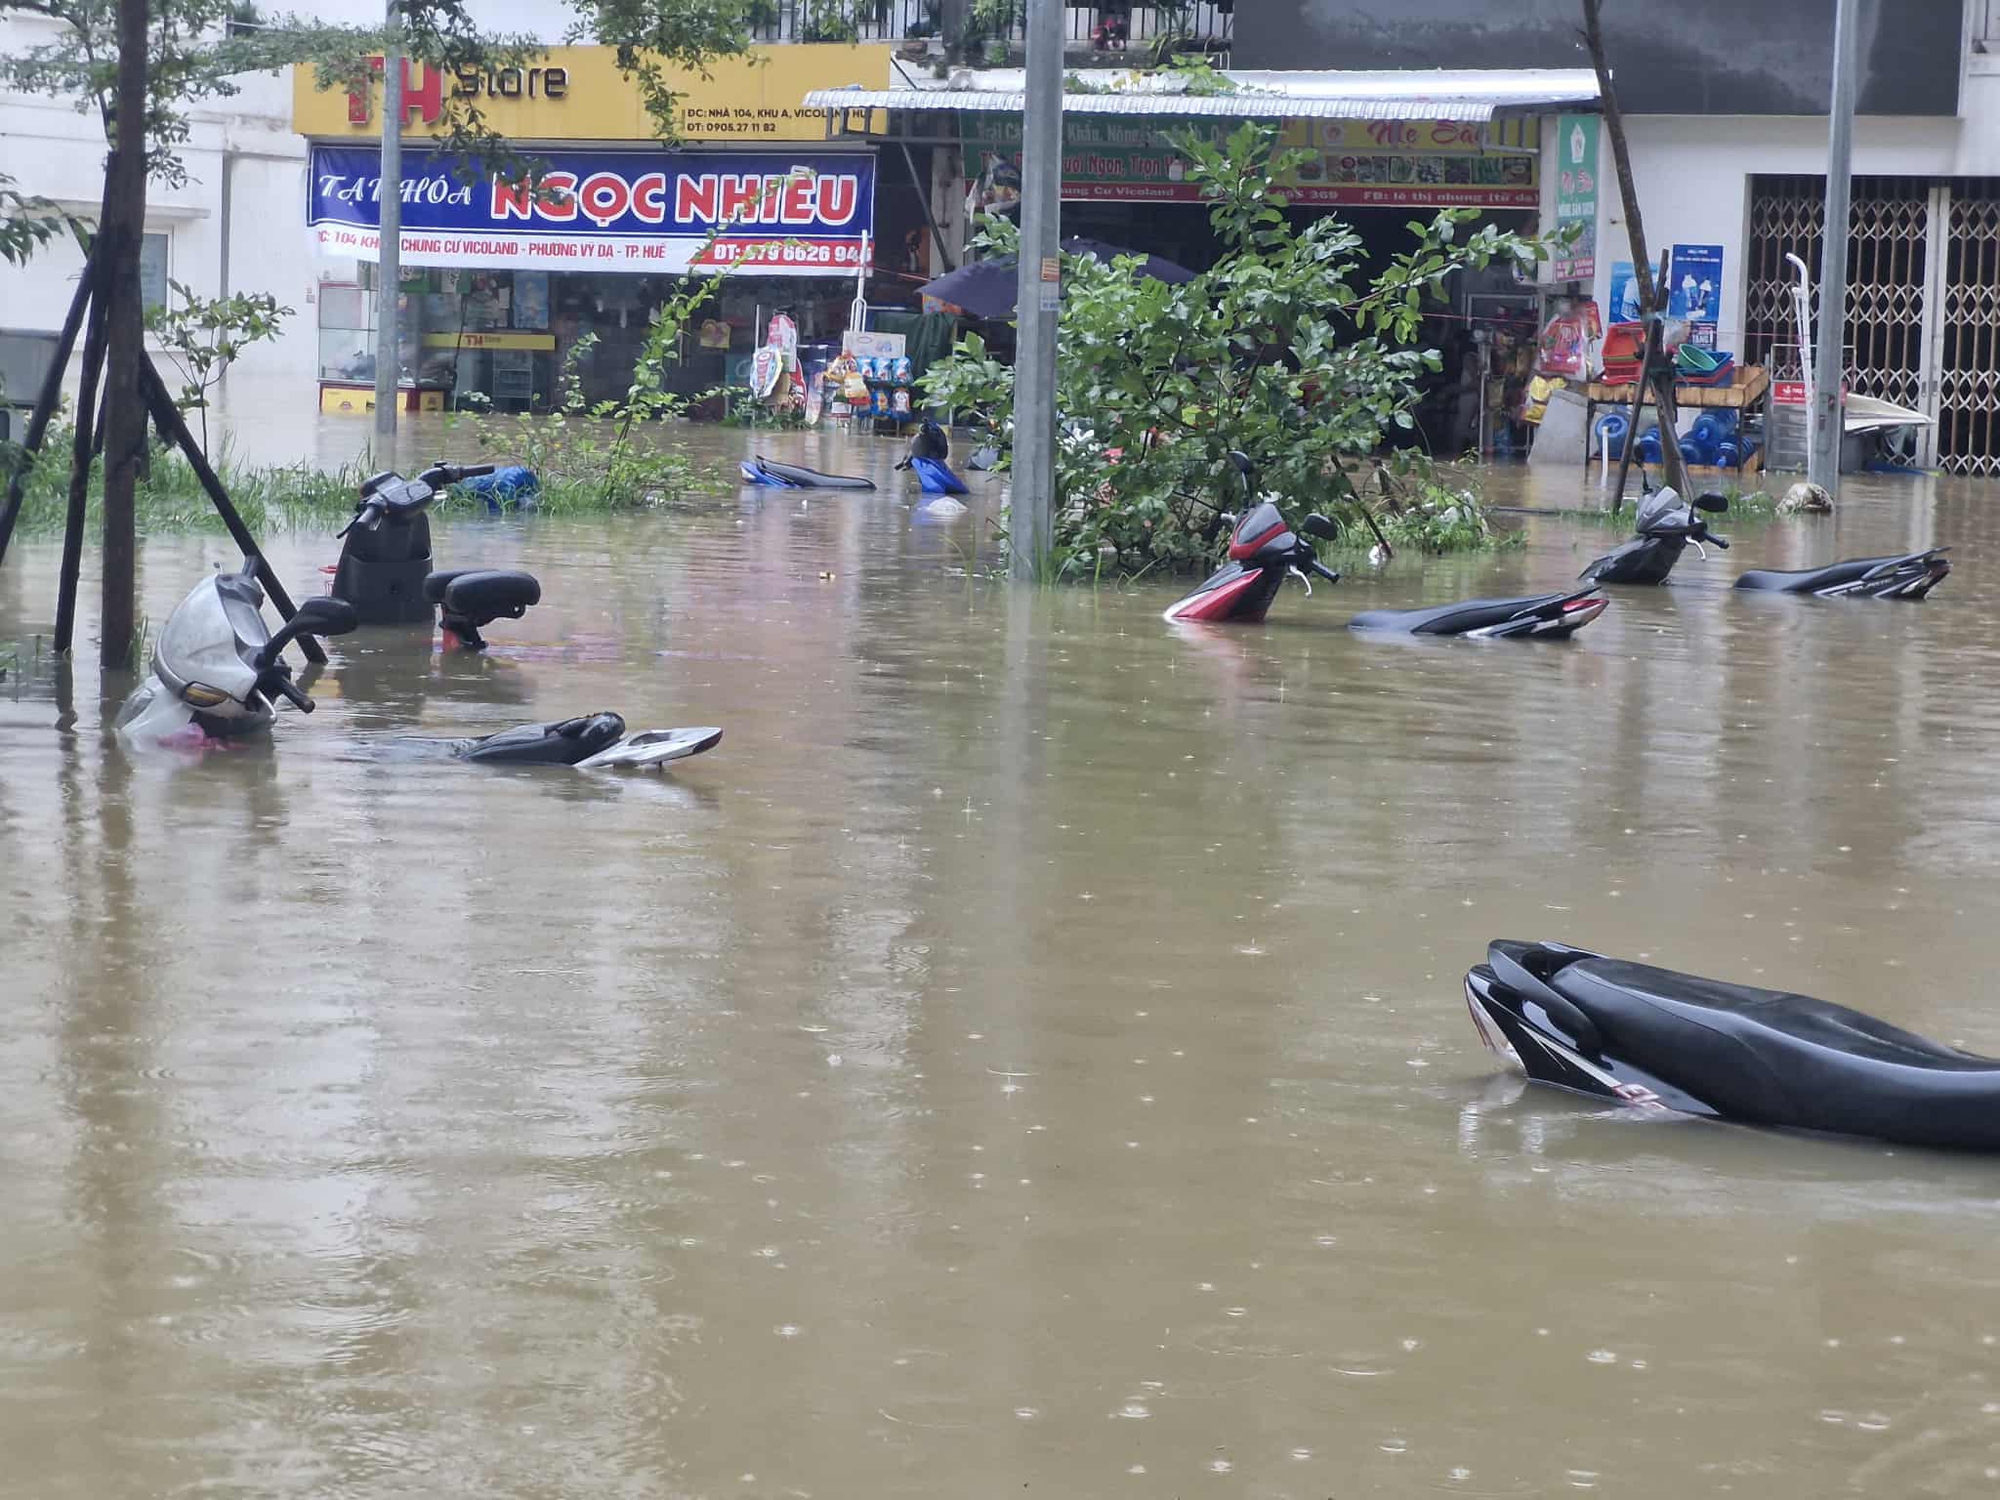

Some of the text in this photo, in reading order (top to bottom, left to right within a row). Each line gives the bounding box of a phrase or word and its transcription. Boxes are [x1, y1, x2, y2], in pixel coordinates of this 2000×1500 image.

[708, 106, 729, 118] NHÀ
[734, 109, 754, 120] 104,
[757, 109, 779, 118] KHU
[781, 109, 792, 119] A,
[706, 122, 748, 132] 0905.27
[763, 123, 775, 132] 82
[491, 172, 666, 227] NGỌC
[401, 239, 441, 253] CHUNG
[462, 240, 518, 255] VICOLAND
[834, 246, 871, 262] 94
